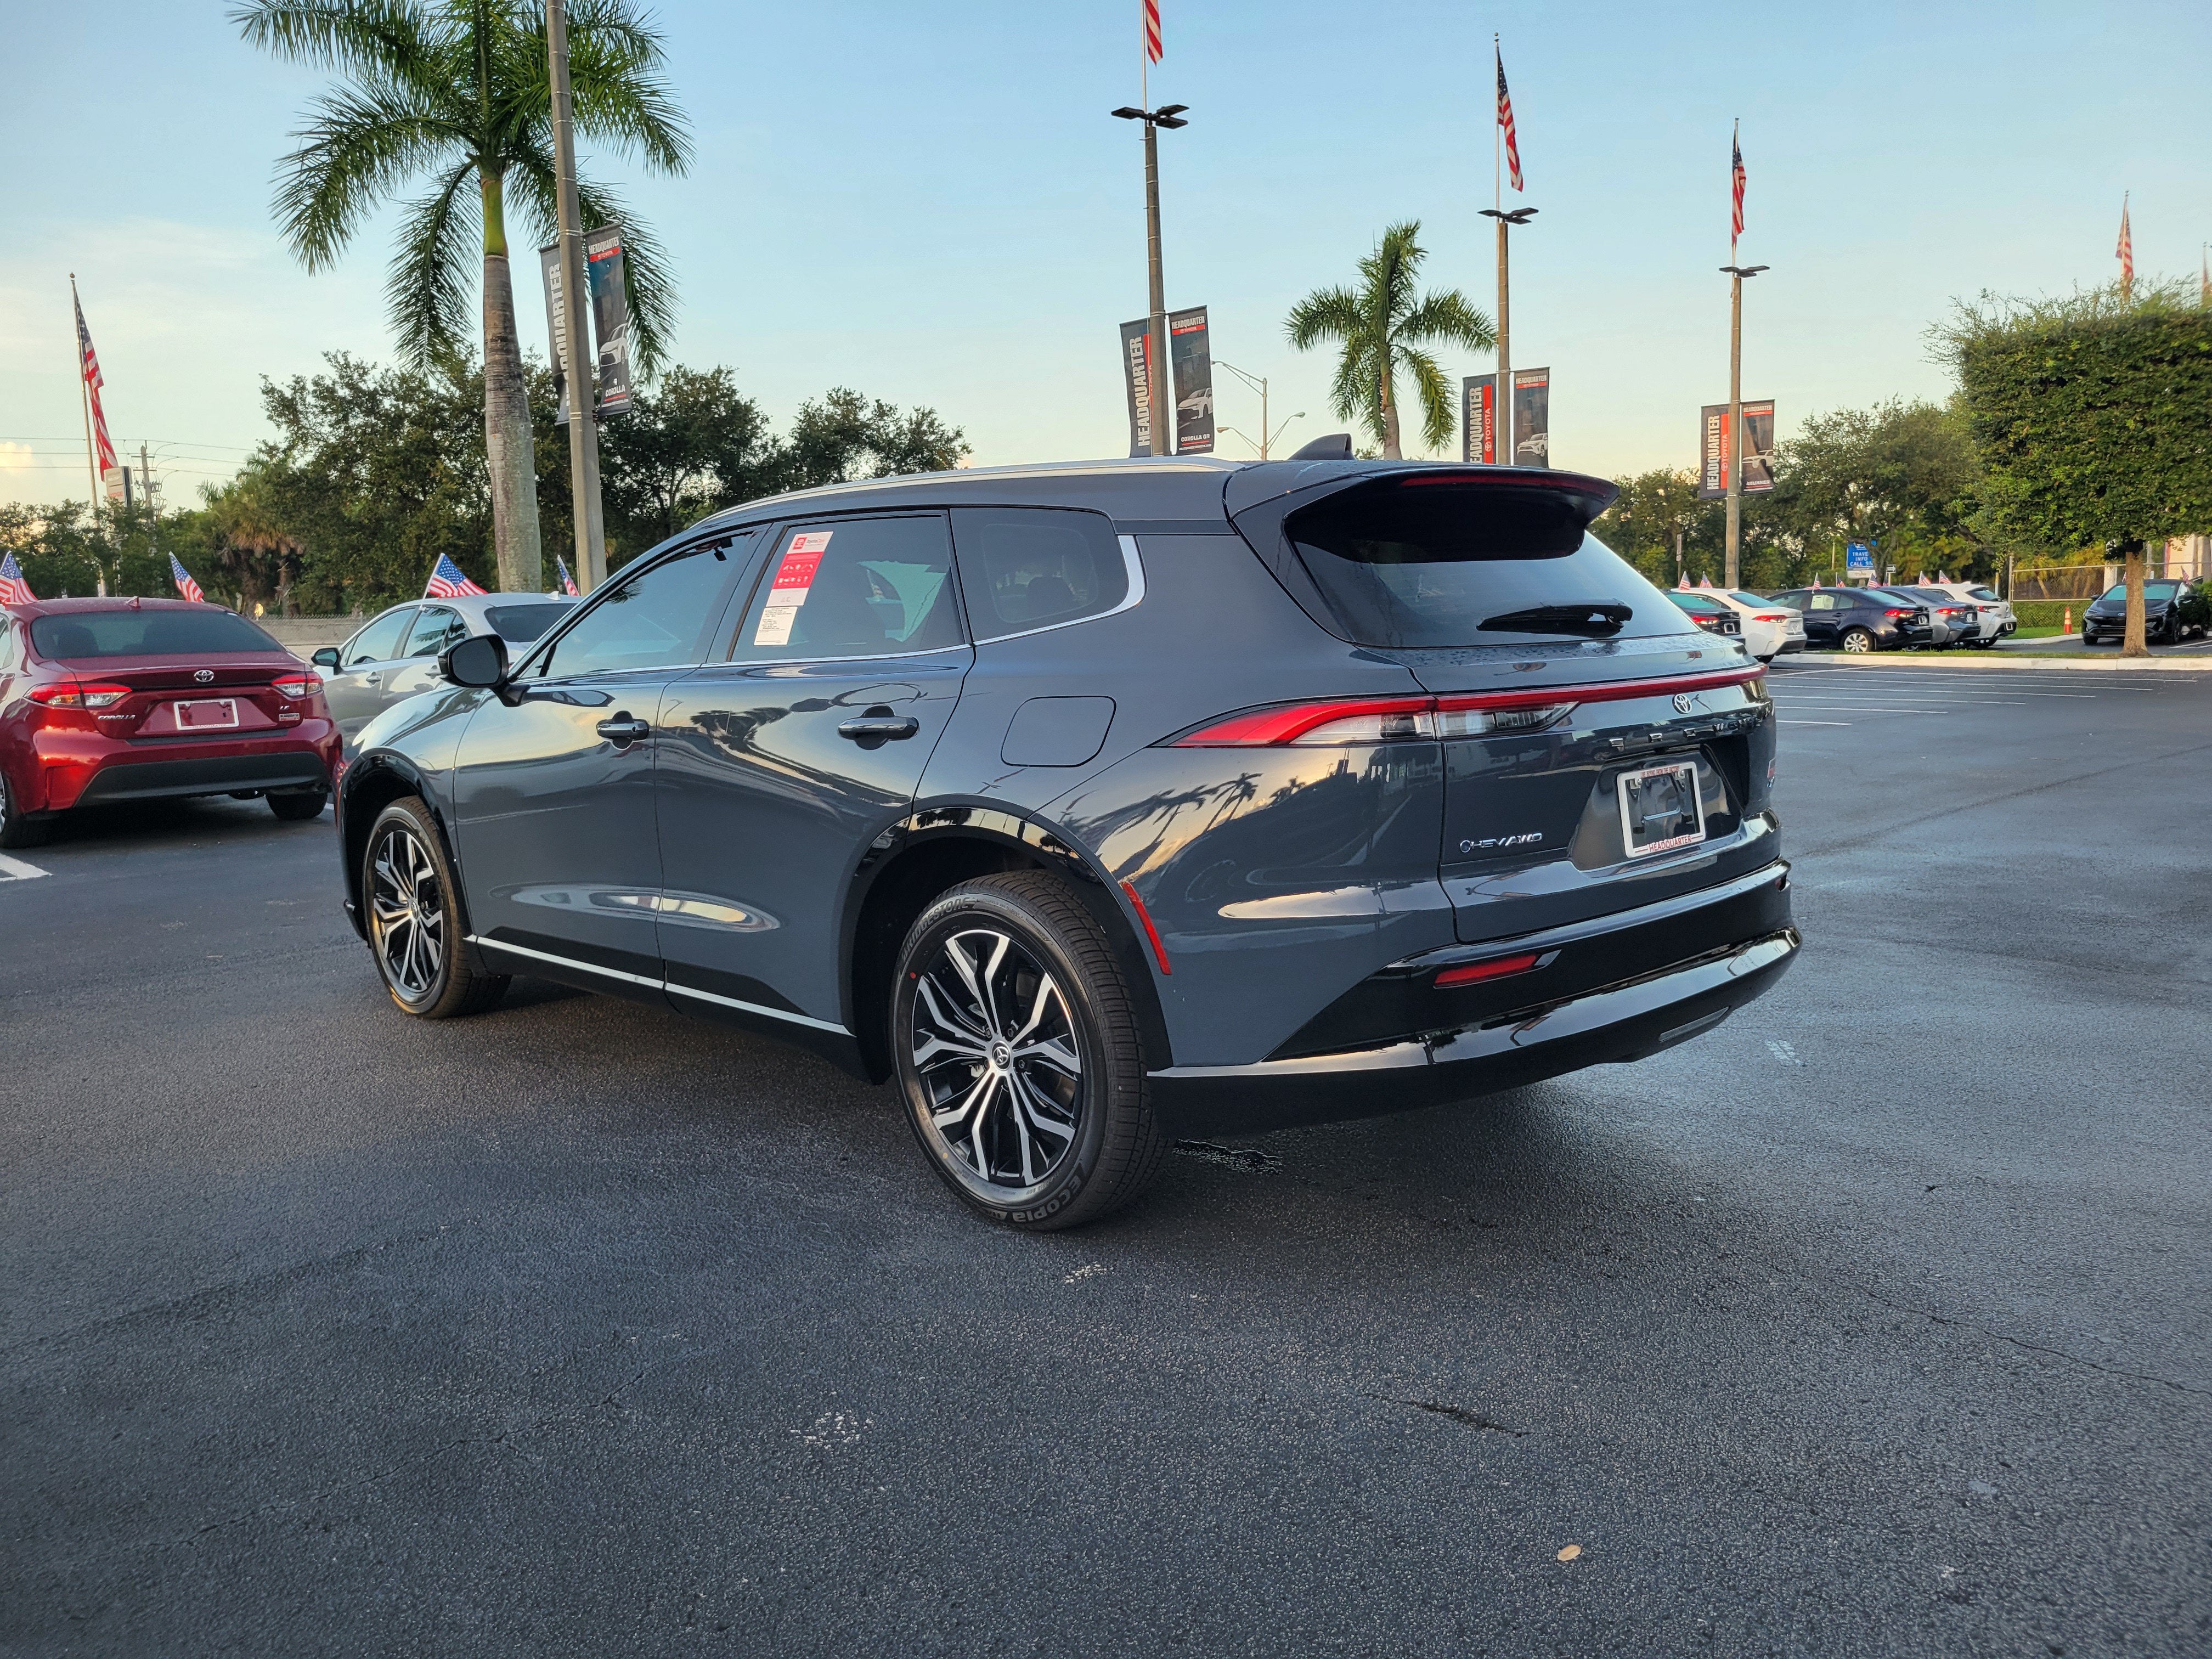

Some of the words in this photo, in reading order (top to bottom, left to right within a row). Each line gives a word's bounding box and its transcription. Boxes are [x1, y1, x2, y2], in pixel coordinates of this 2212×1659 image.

[1171, 316, 1205, 329] HEADQUARTER
[605, 384, 626, 397] COROLLA
[1130, 336, 1150, 447] HEADQUARTER
[1469, 387, 1483, 464] EADQUARTER
[1707, 415, 1720, 490] HEADQUARTER
[1649, 836, 1692, 853] HEADQUARTER
[901, 897, 970, 963] BRIDGESTONE
